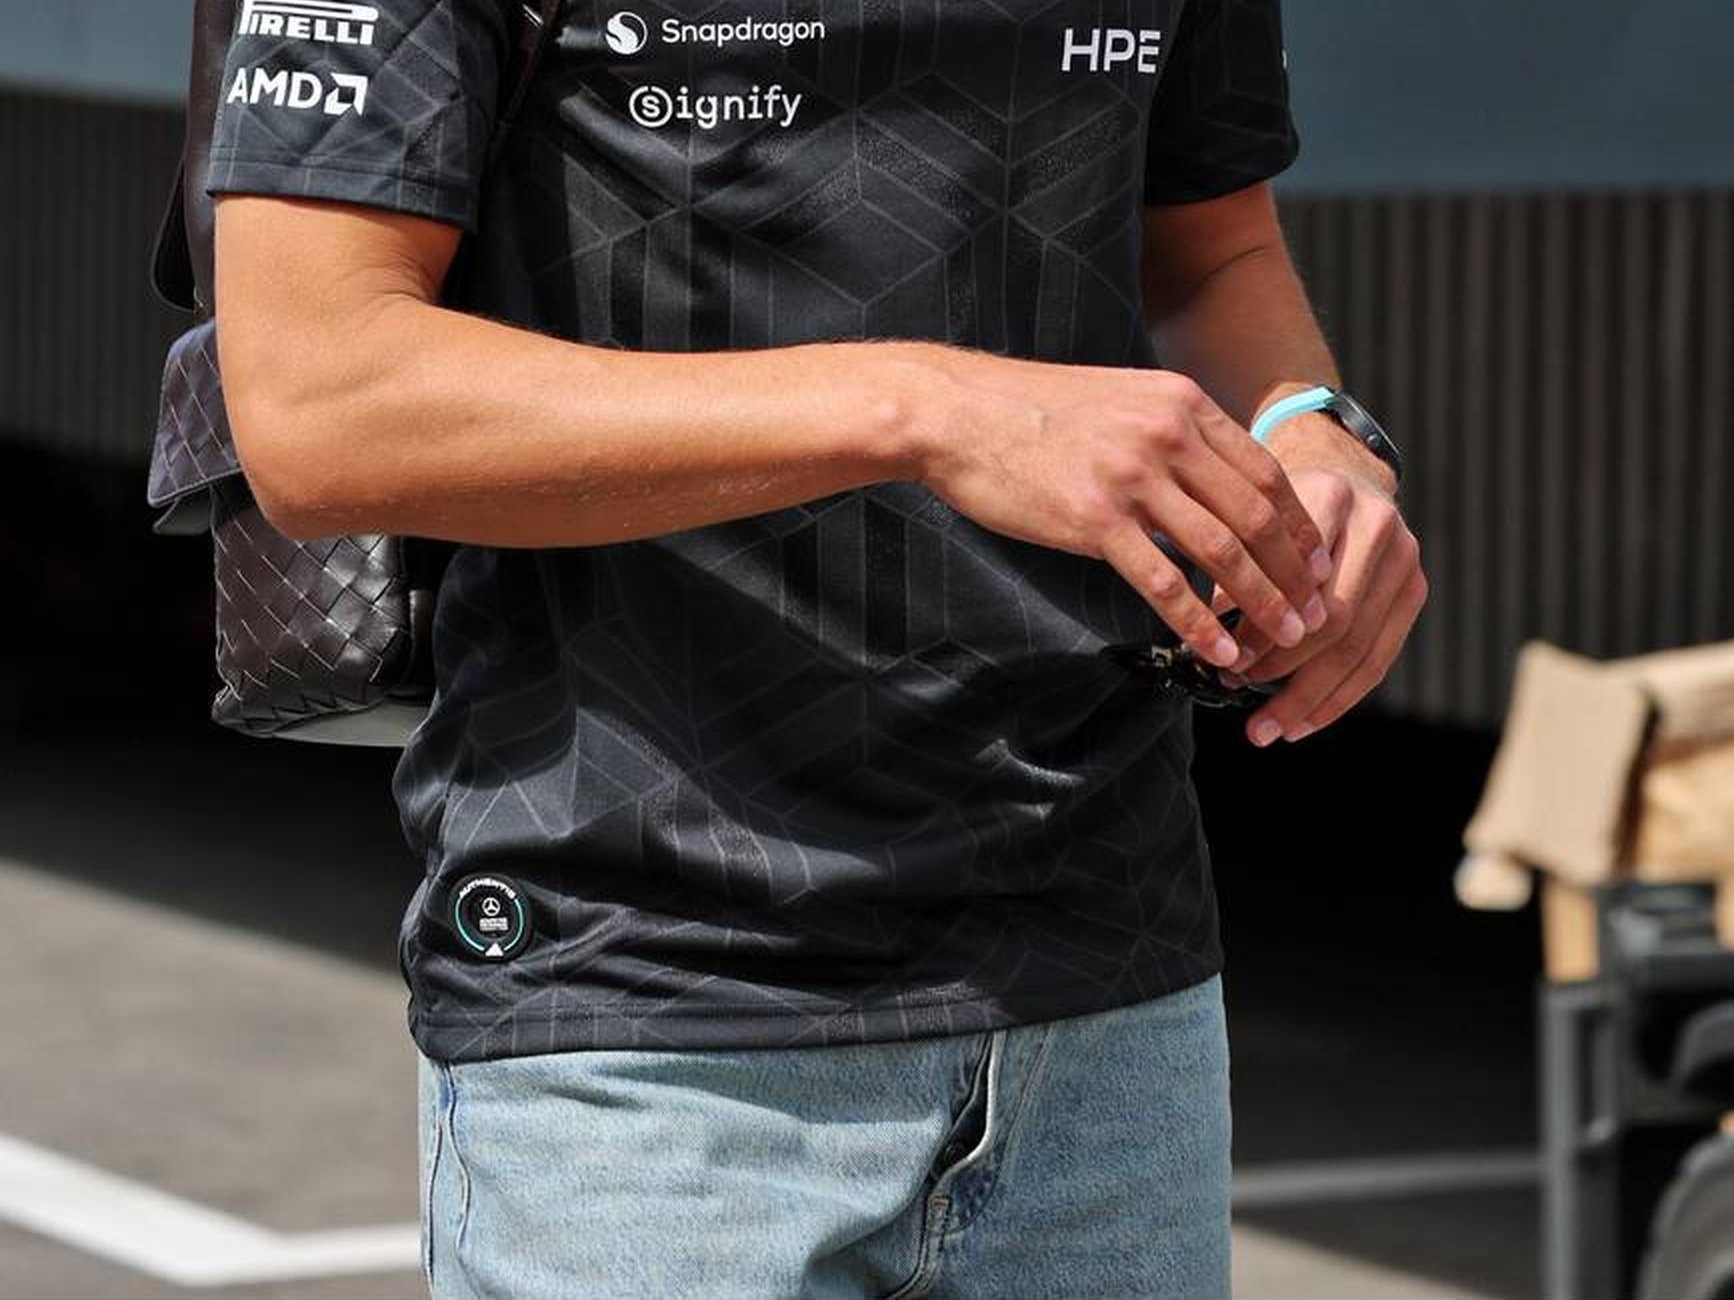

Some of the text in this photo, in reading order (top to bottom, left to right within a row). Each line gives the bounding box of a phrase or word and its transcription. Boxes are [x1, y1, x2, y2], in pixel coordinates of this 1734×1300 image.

[661, 16, 826, 48] Snapdragon
[1061, 28, 1161, 73] HPE
[226, 67, 323, 109] AMD
